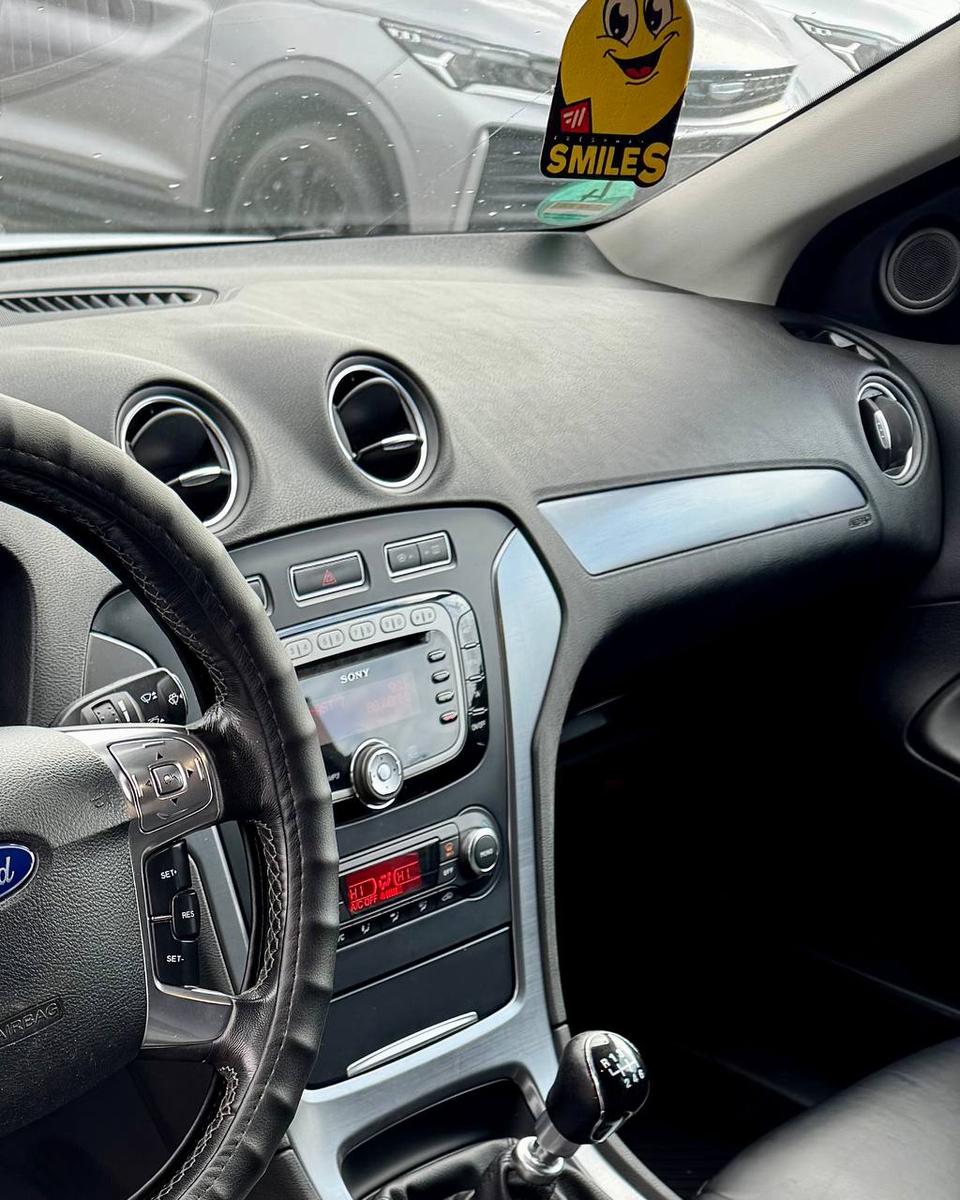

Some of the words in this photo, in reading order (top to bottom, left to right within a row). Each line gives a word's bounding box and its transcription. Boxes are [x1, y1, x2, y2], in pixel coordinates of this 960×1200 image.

[546, 142, 670, 184] SMILES
[340, 668, 370, 685] SONY
[160, 869, 177, 880] SET+
[181, 910, 195, 919] RES
[166, 954, 185, 963] SET-
[600, 1057, 611, 1069] R
[623, 1078, 632, 1089] 2
